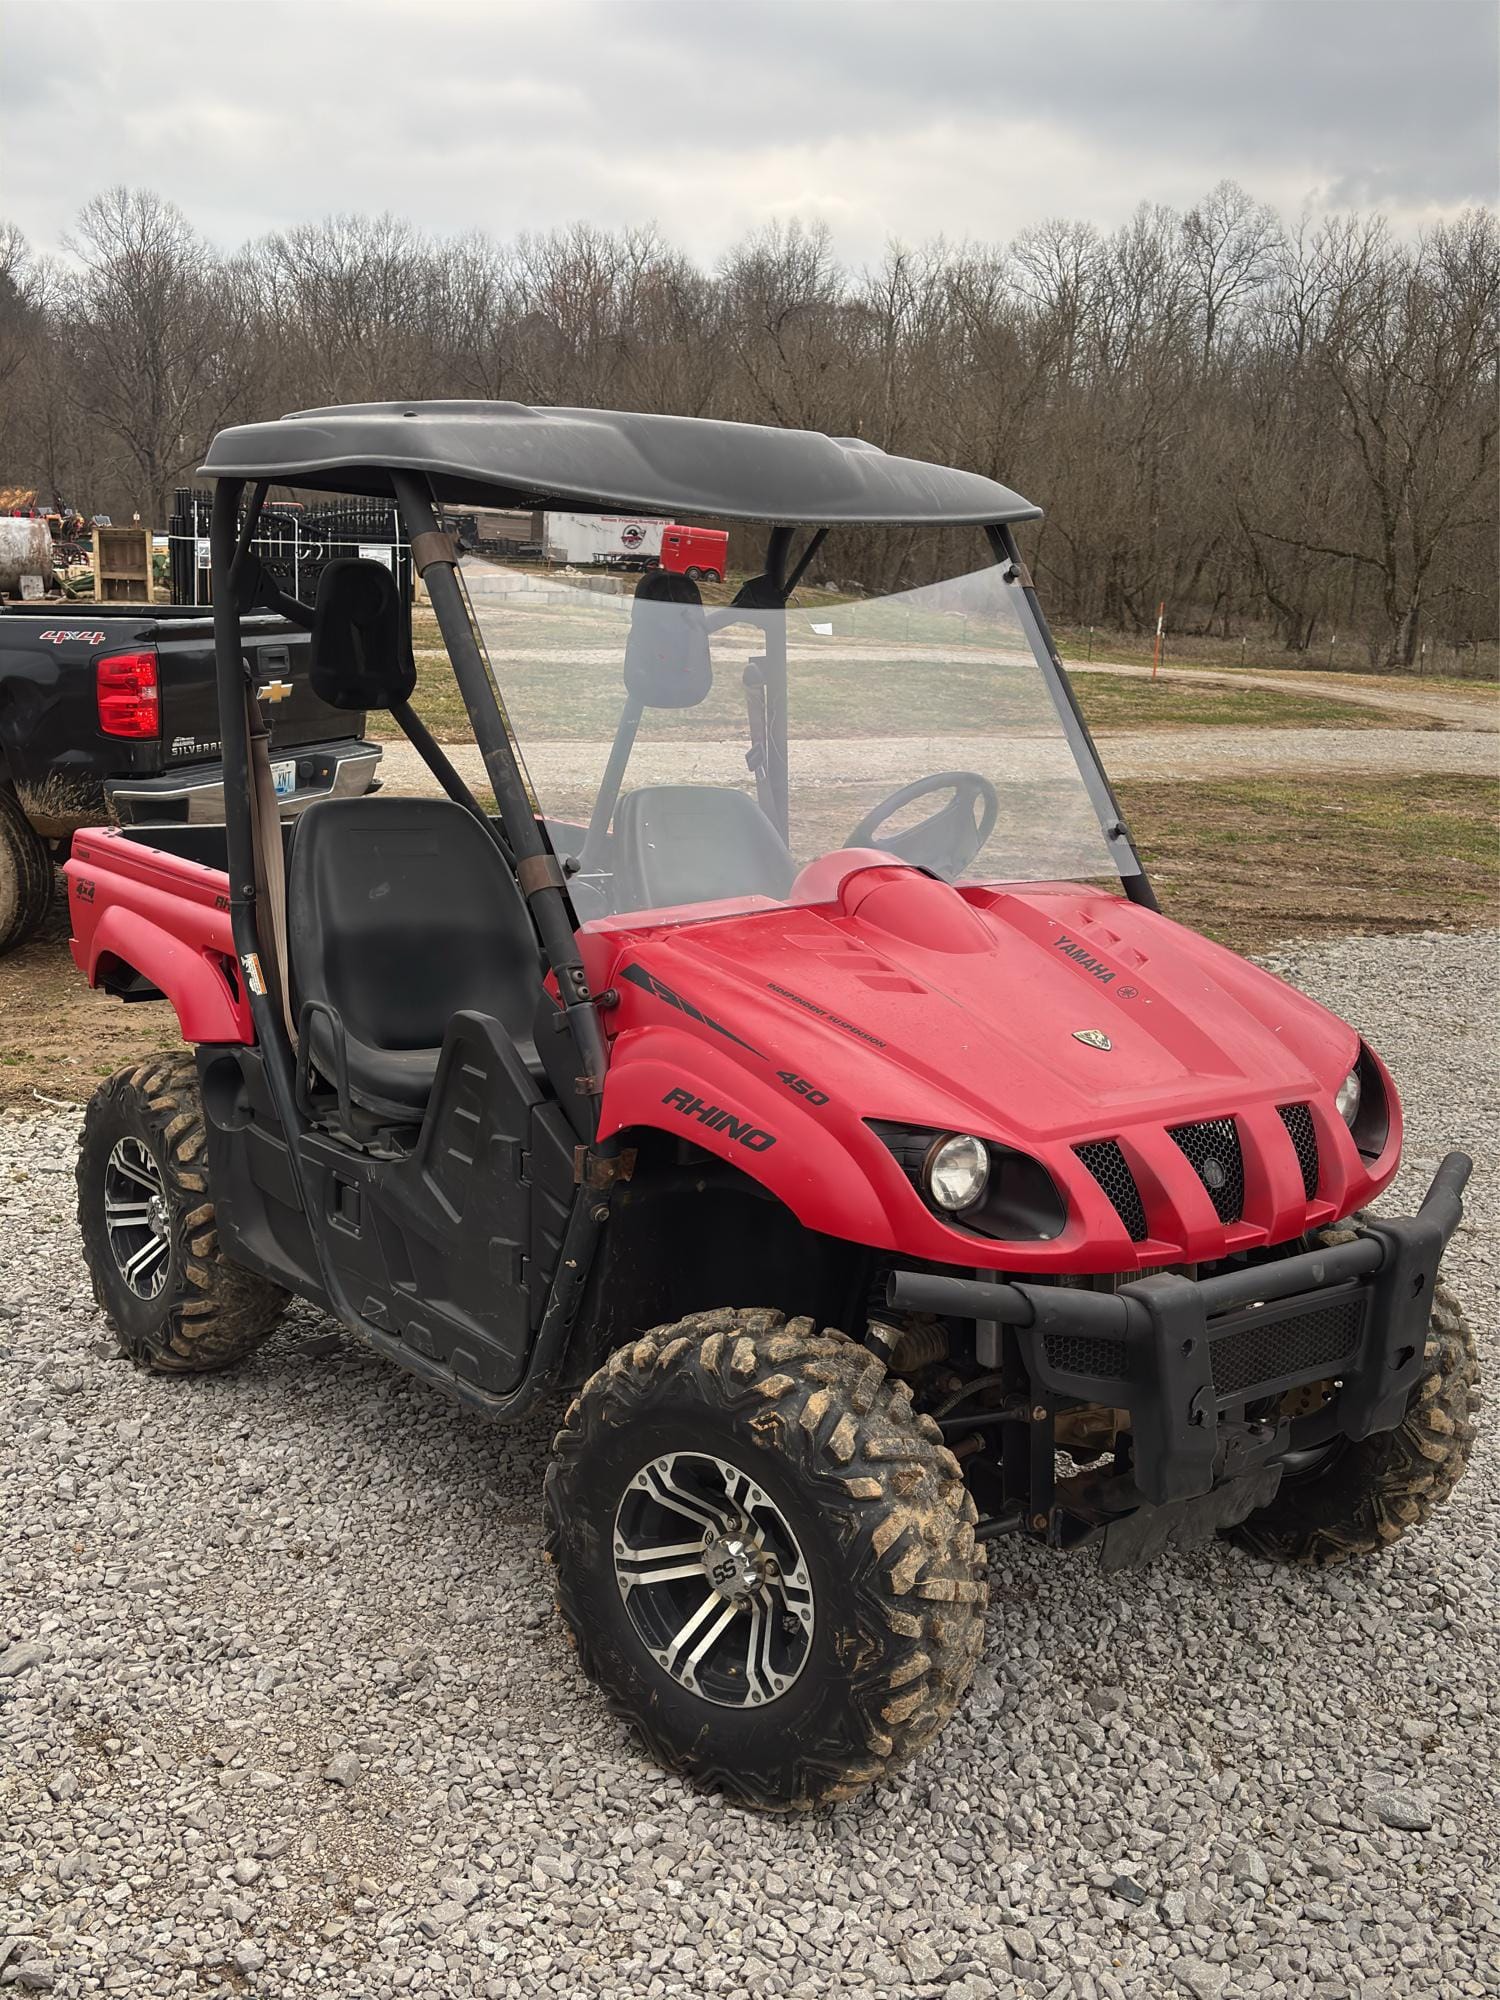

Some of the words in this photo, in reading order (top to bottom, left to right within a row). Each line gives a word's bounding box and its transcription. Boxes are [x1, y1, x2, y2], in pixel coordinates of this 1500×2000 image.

[1053, 935, 1117, 984] YAMAHA
[767, 982, 828, 1016] INDEPENDENT
[827, 1015, 887, 1048] SUSPENSION
[776, 1070, 830, 1106] 450
[661, 1087, 777, 1152] RHINO
[712, 1558, 737, 1586] SS
